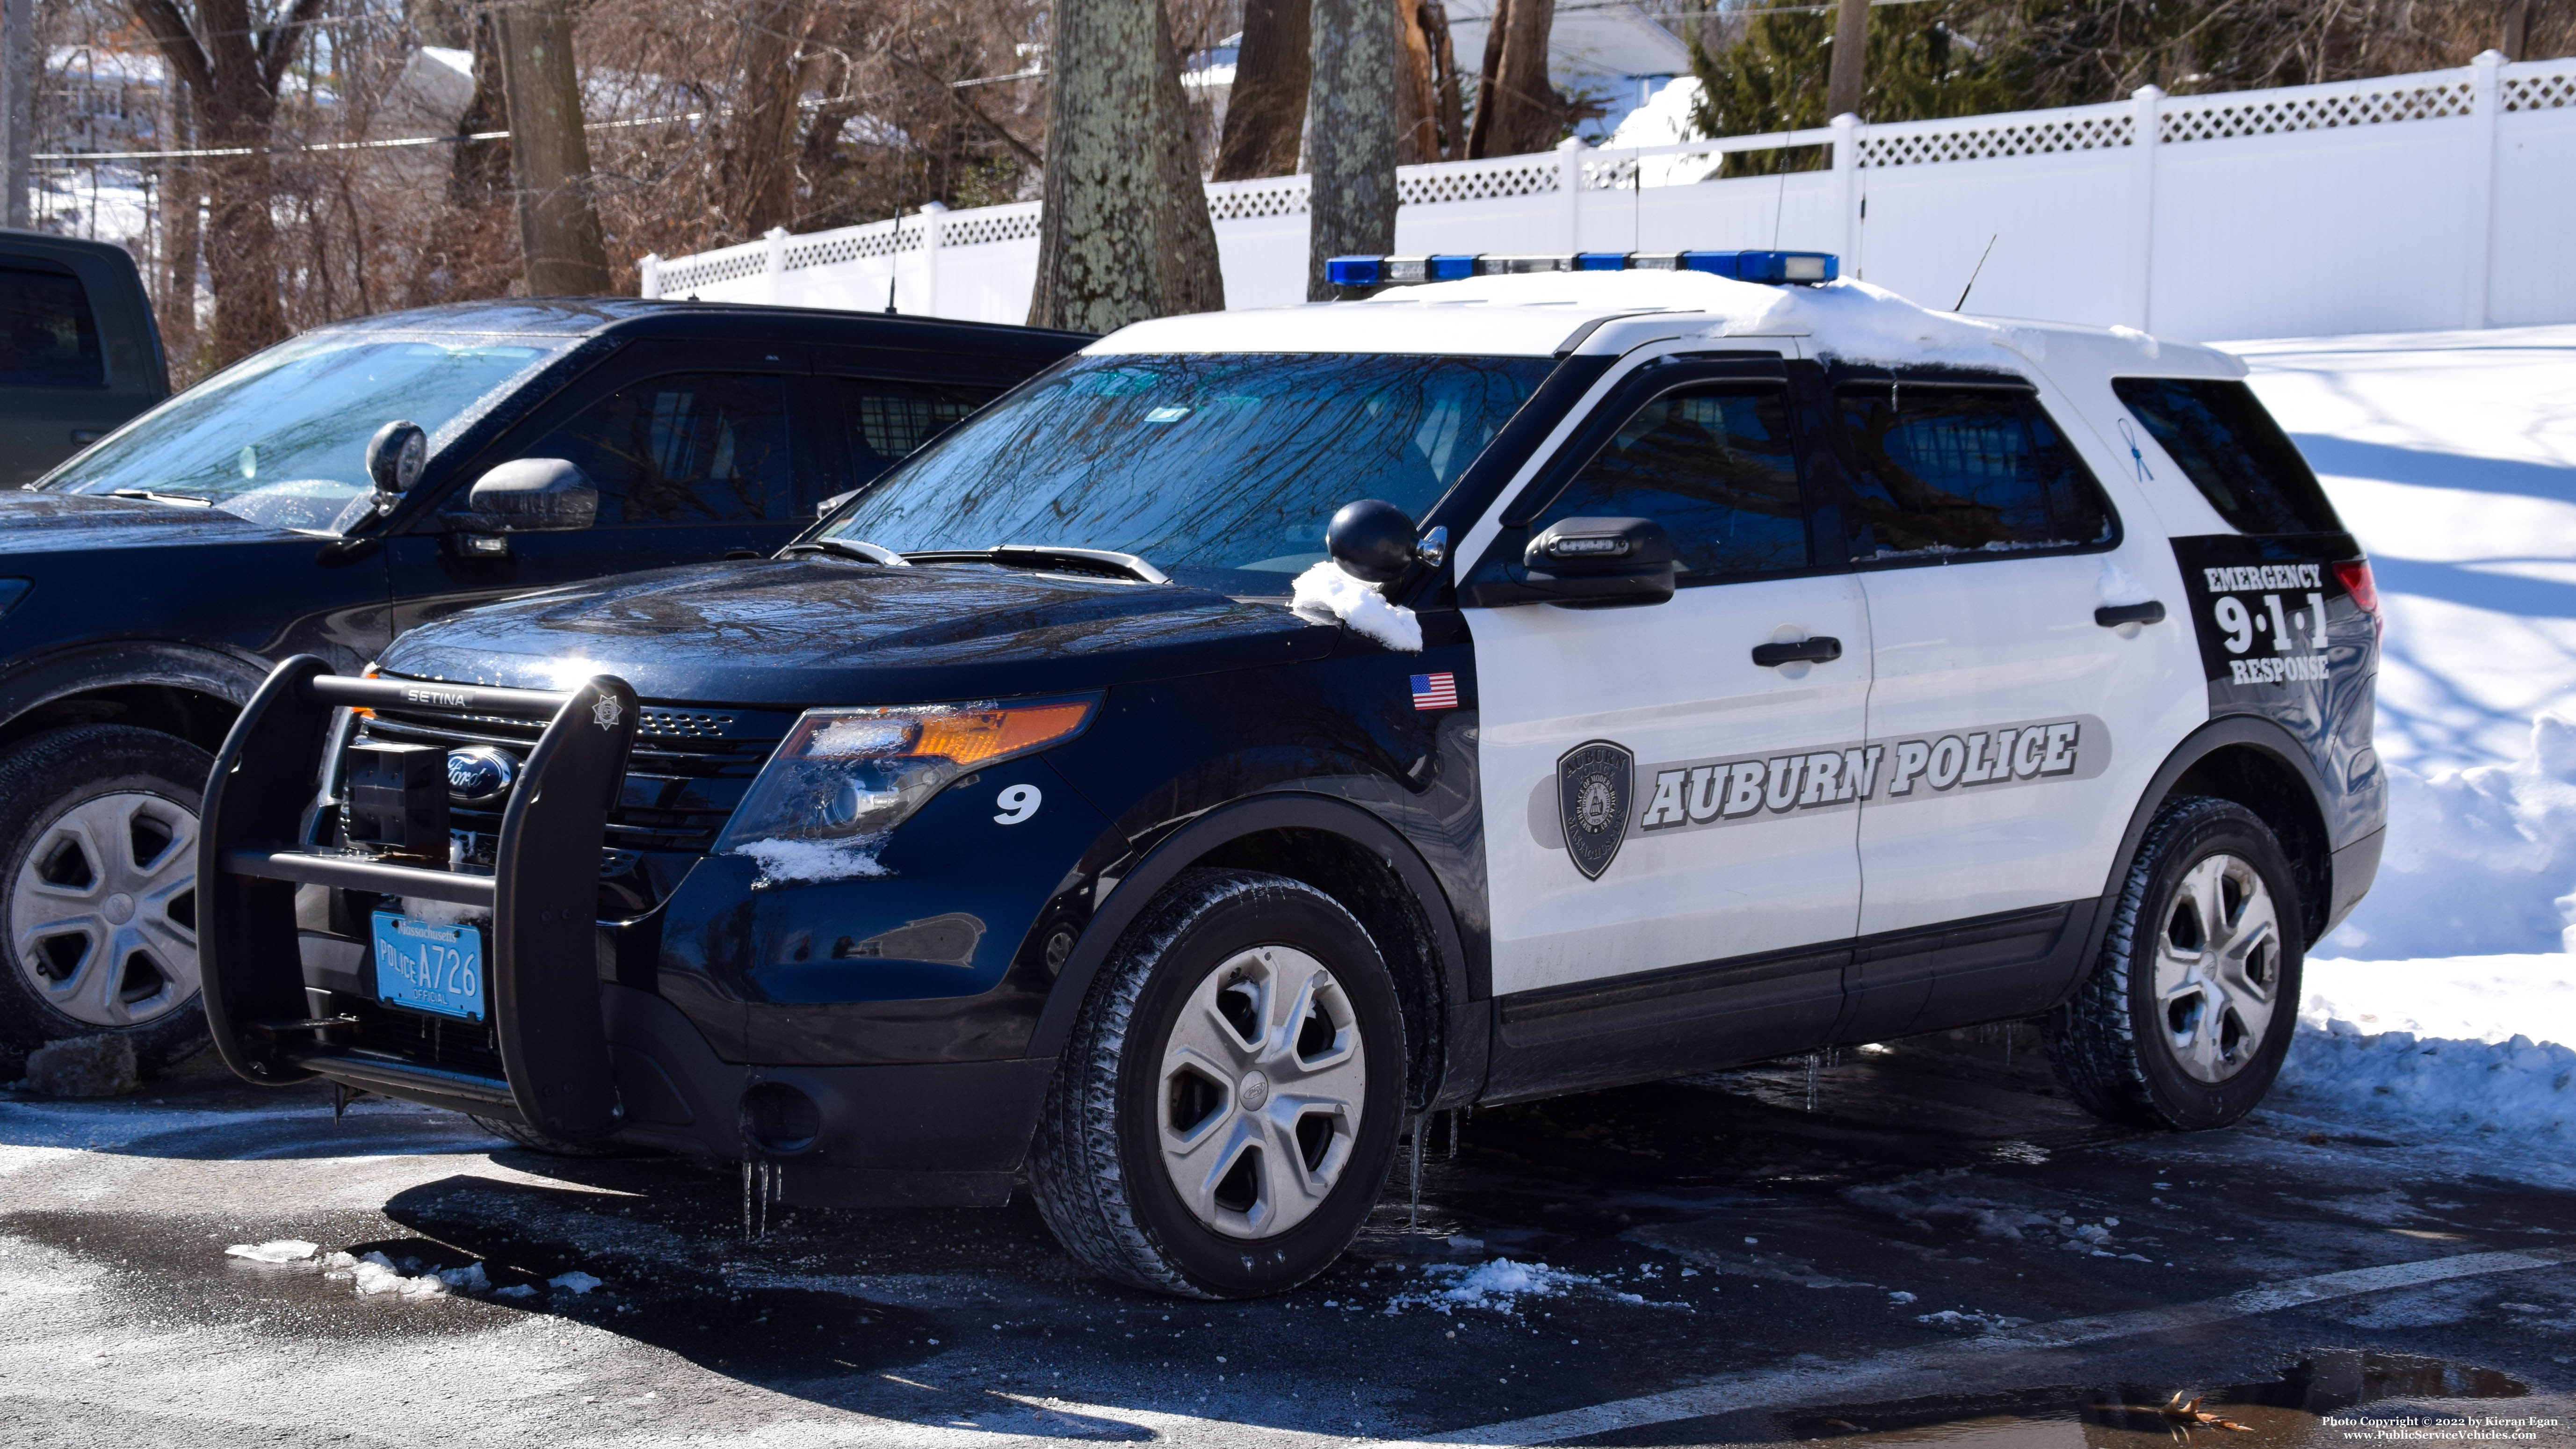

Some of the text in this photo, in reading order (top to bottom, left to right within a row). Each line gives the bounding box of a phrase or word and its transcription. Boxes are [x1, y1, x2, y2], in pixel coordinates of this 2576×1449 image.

[2203, 564, 2323, 592] EMERGENCY
[2229, 655, 2329, 685] RESPONSE
[408, 689, 466, 707] SETINA
[448, 756, 487, 786] Ford
[1567, 749, 1626, 778] AUBURN
[1576, 764, 1616, 785] POLICE
[1641, 721, 2079, 831] AUBURN POLICE
[1583, 778, 1590, 789] OF
[1591, 775, 1614, 791] MODERN
[993, 784, 1042, 825] 9
[398, 920, 456, 943] Massachusetts
[380, 938, 476, 997] POLICE A726
[413, 988, 449, 1005] OFFICIAL
